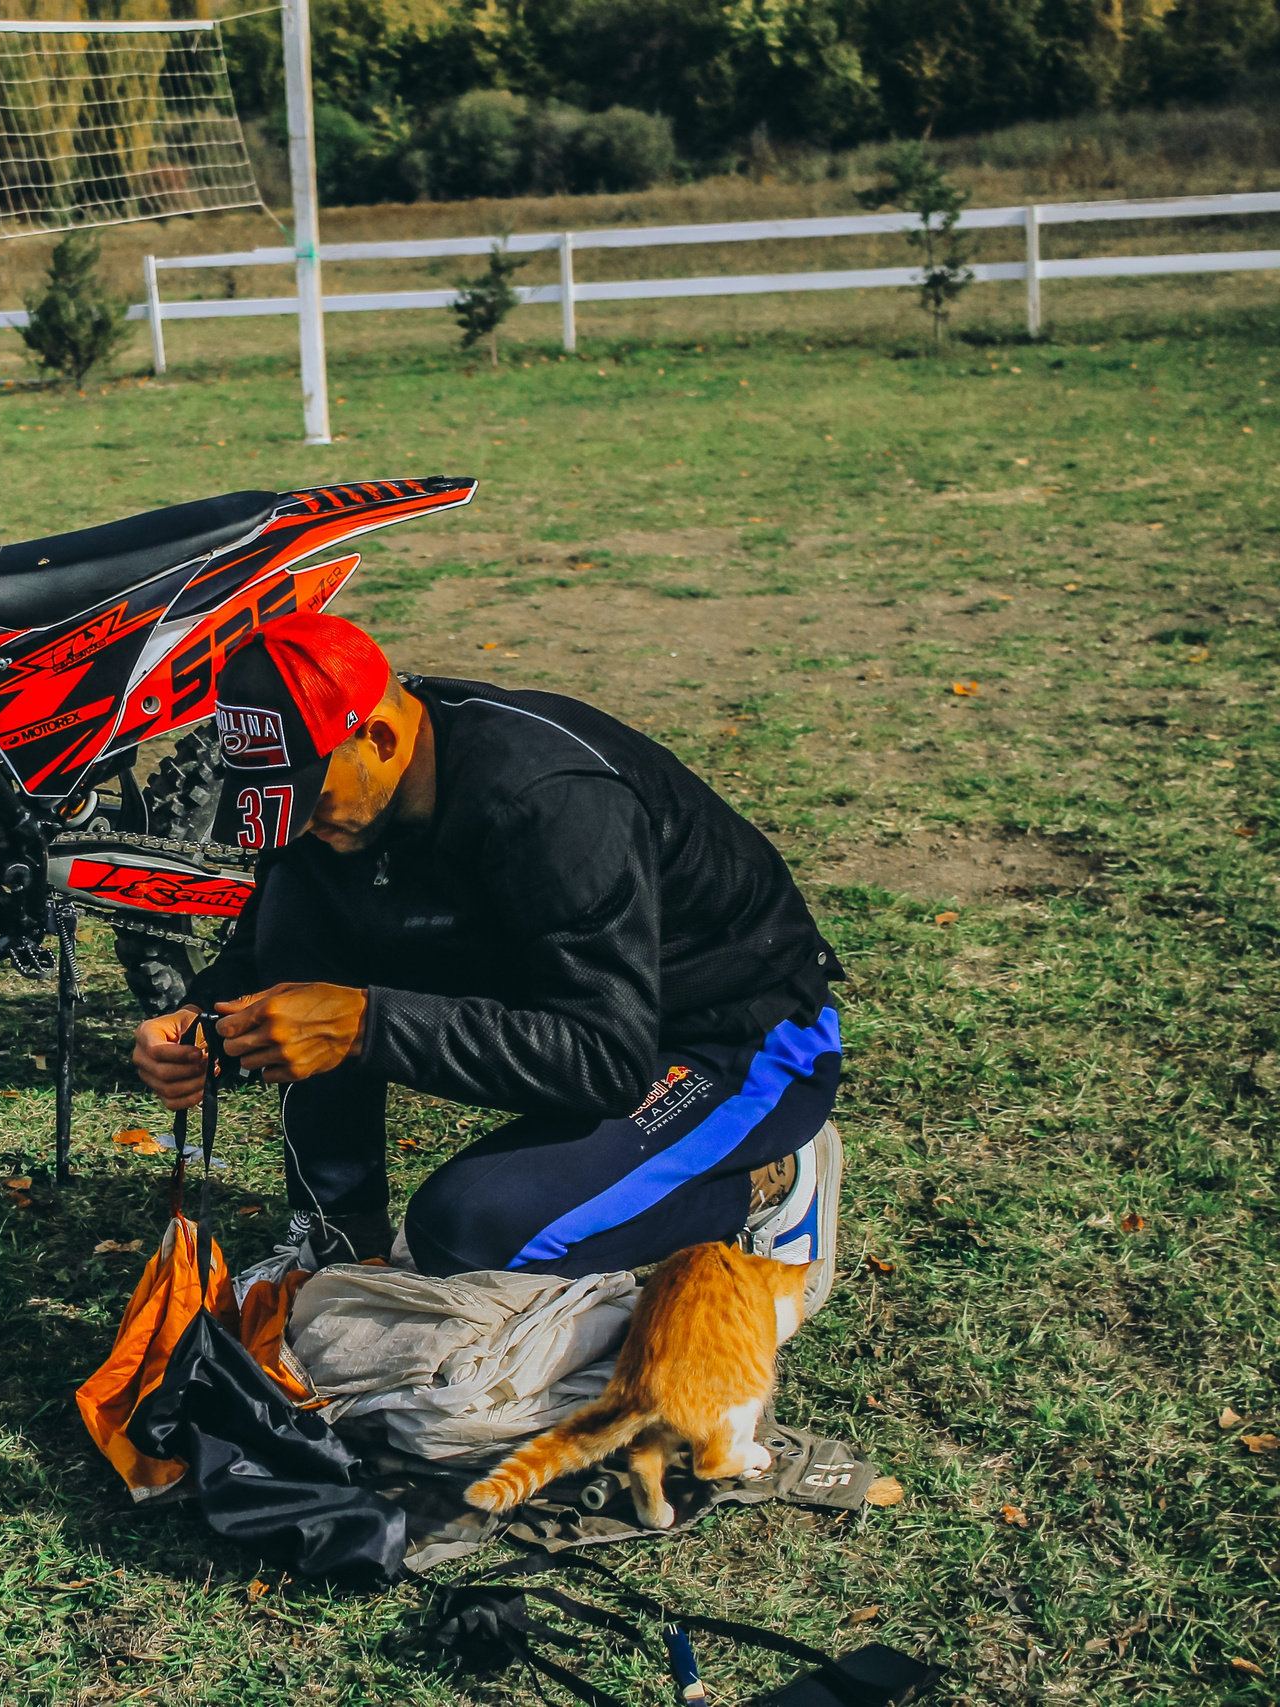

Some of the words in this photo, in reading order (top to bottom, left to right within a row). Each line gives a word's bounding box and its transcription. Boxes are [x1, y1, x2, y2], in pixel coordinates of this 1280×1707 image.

[53, 638, 107, 672] RACING
[20, 710, 82, 741] MOTOREX
[236, 784, 294, 849] 37
[122, 878, 247, 906] Rentha
[646, 1108, 682, 1136] FORMULA
[682, 1095, 697, 1109] ONE
